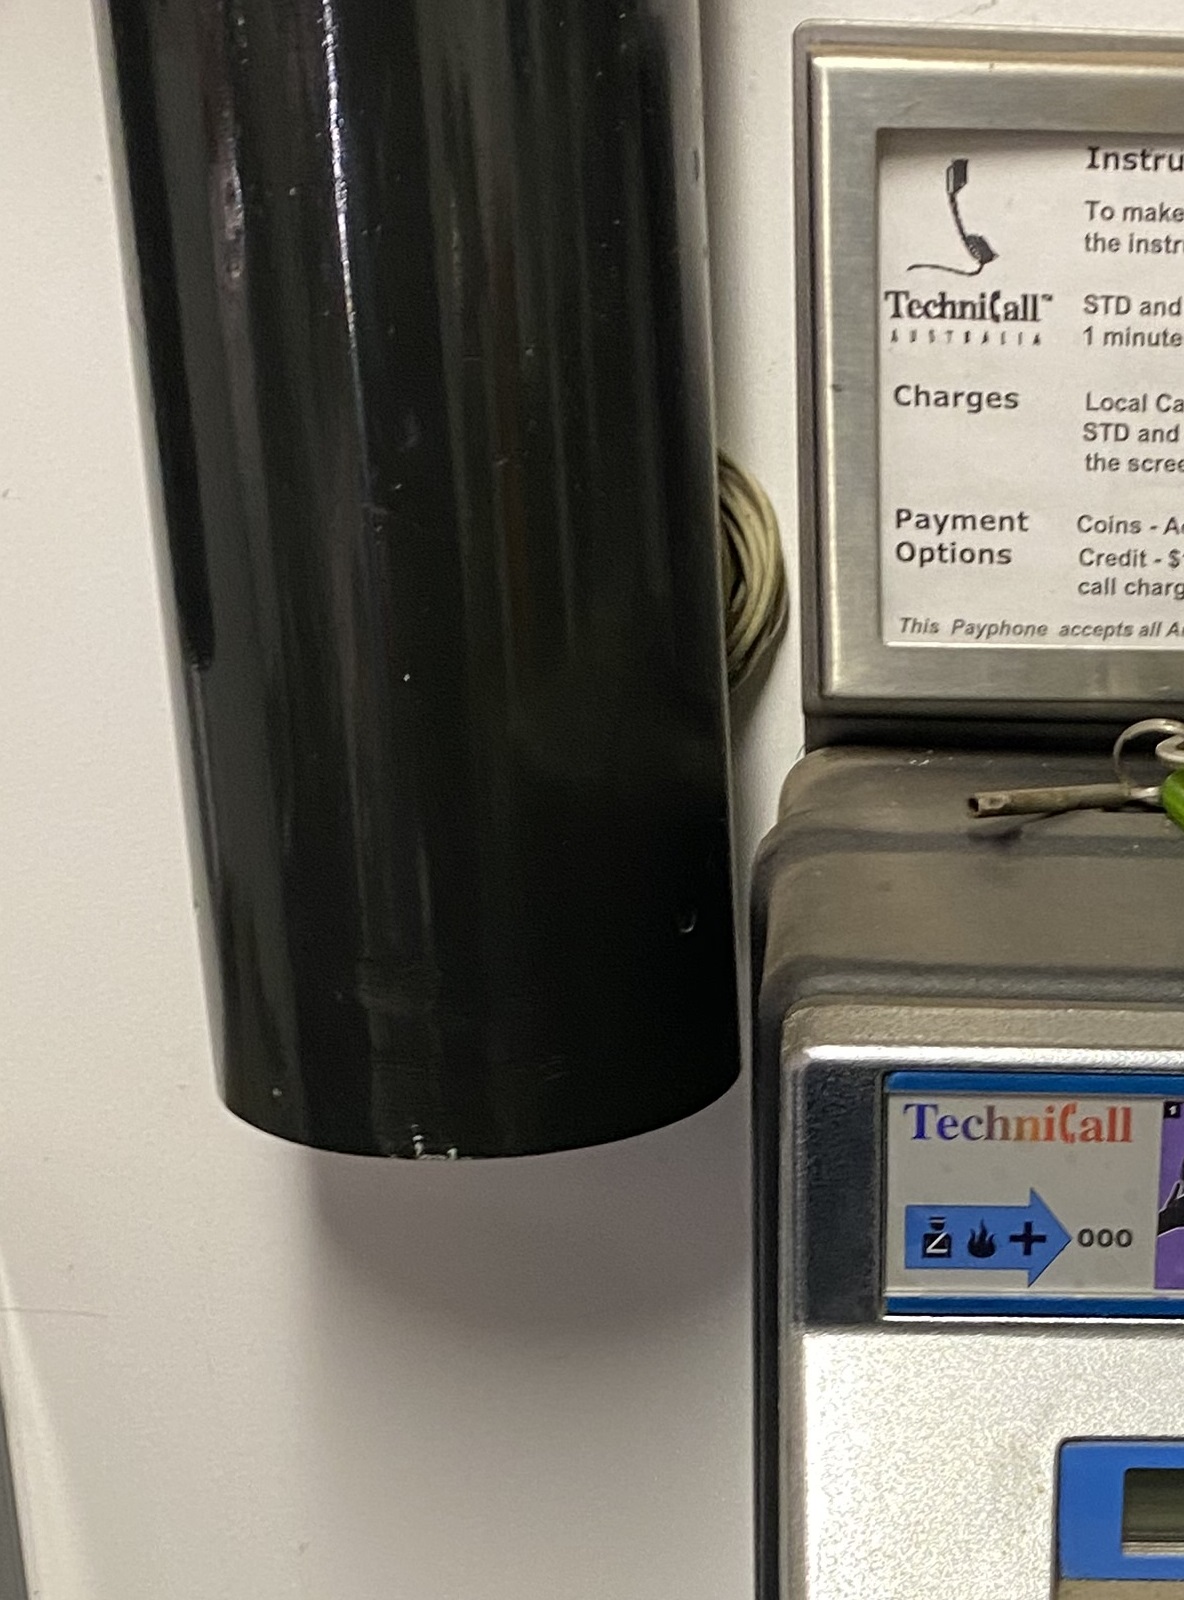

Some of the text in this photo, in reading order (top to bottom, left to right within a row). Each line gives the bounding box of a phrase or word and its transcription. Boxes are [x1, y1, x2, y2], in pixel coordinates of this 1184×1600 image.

[1085, 200, 1116, 223] To
[1084, 232, 1122, 254] the
[1083, 294, 1132, 316] STD
[1138, 296, 1183, 317] and
[1083, 325, 1093, 347] 1
[1103, 325, 1184, 348] minute
[893, 383, 1020, 413] Charges
[1086, 391, 1148, 414] Local
[1082, 422, 1131, 443] STD
[1137, 423, 1180, 445] and
[1084, 452, 1121, 472] the
[895, 508, 1030, 536] Payment
[1076, 514, 1142, 535] Coins
[895, 541, 1012, 569] Options
[1079, 547, 1148, 569] Credit
[1077, 578, 1117, 597] call
[899, 617, 941, 635] This
[950, 619, 1048, 640] Payphone
[1057, 621, 1134, 641] accepts
[1138, 621, 1163, 638] all
